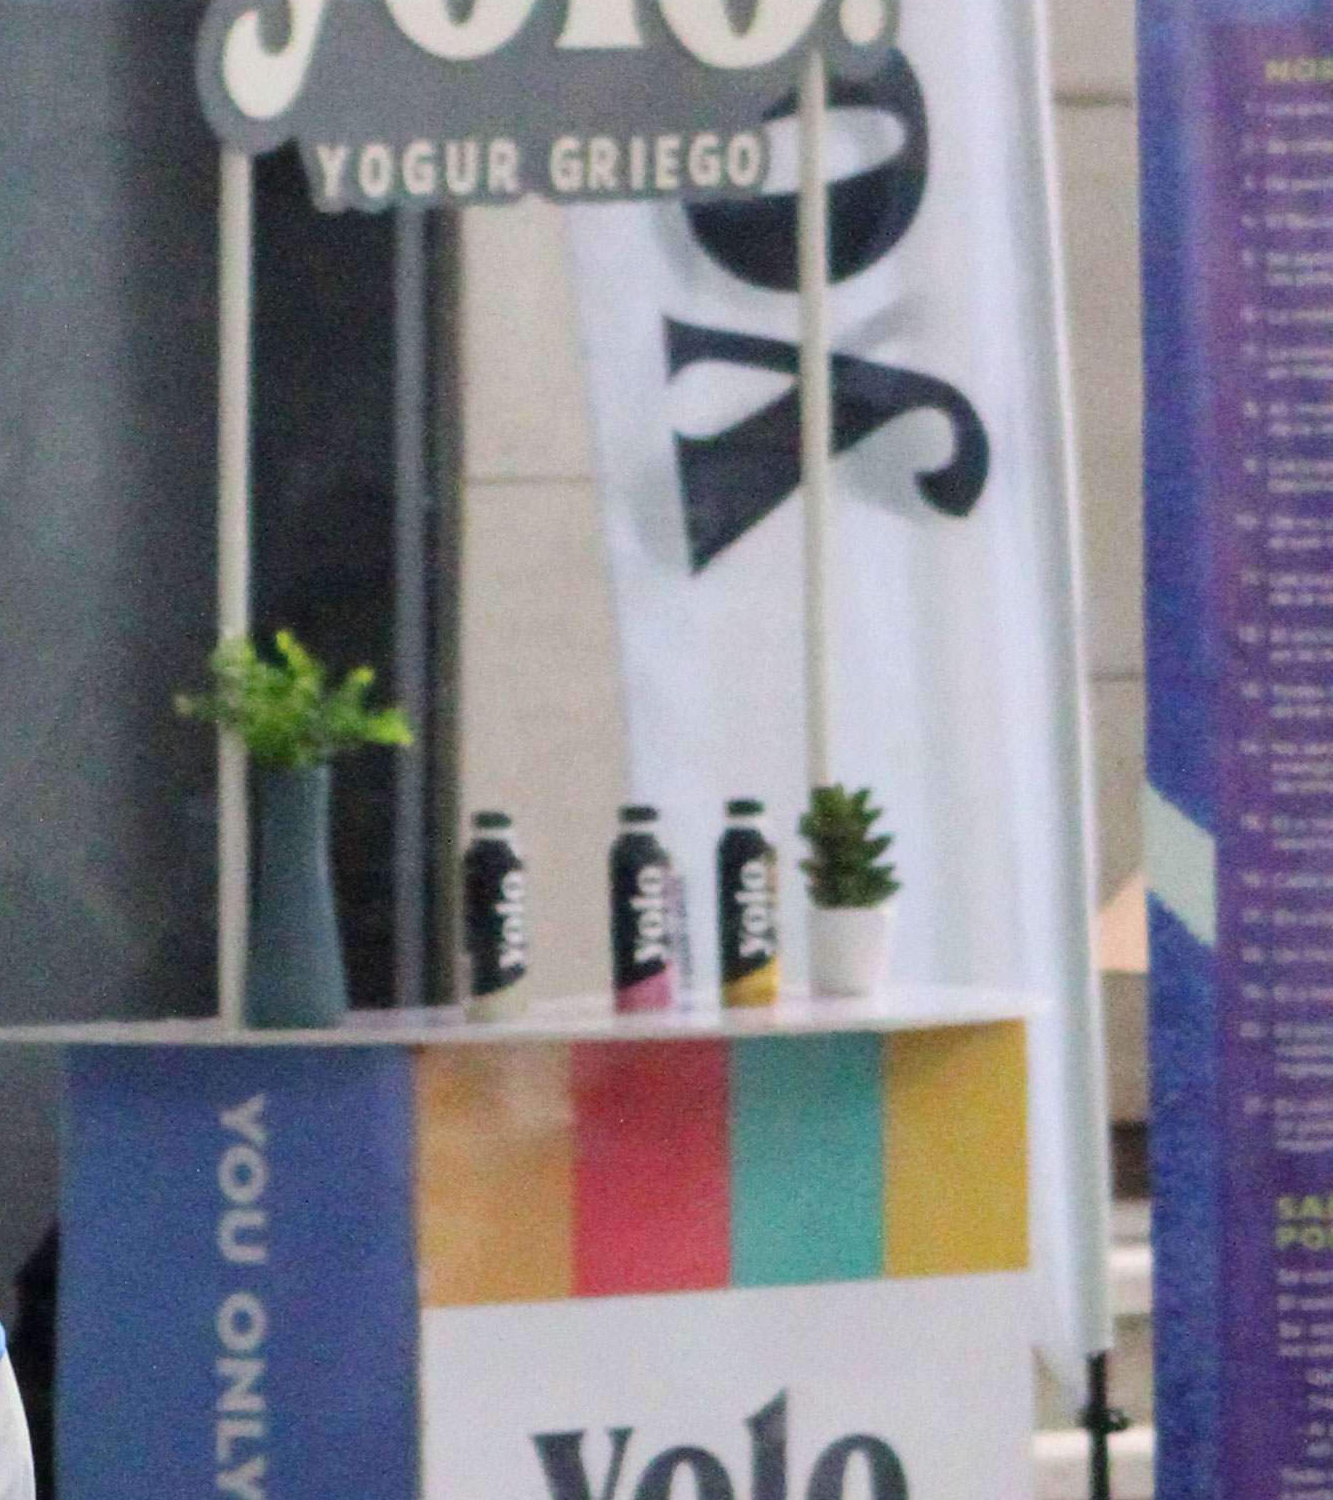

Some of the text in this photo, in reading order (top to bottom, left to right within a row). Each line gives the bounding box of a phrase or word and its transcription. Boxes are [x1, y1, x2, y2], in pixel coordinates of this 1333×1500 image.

[315, 130, 763, 201] YOGUR GRIEGO
[217, 1093, 269, 1264] YOU
